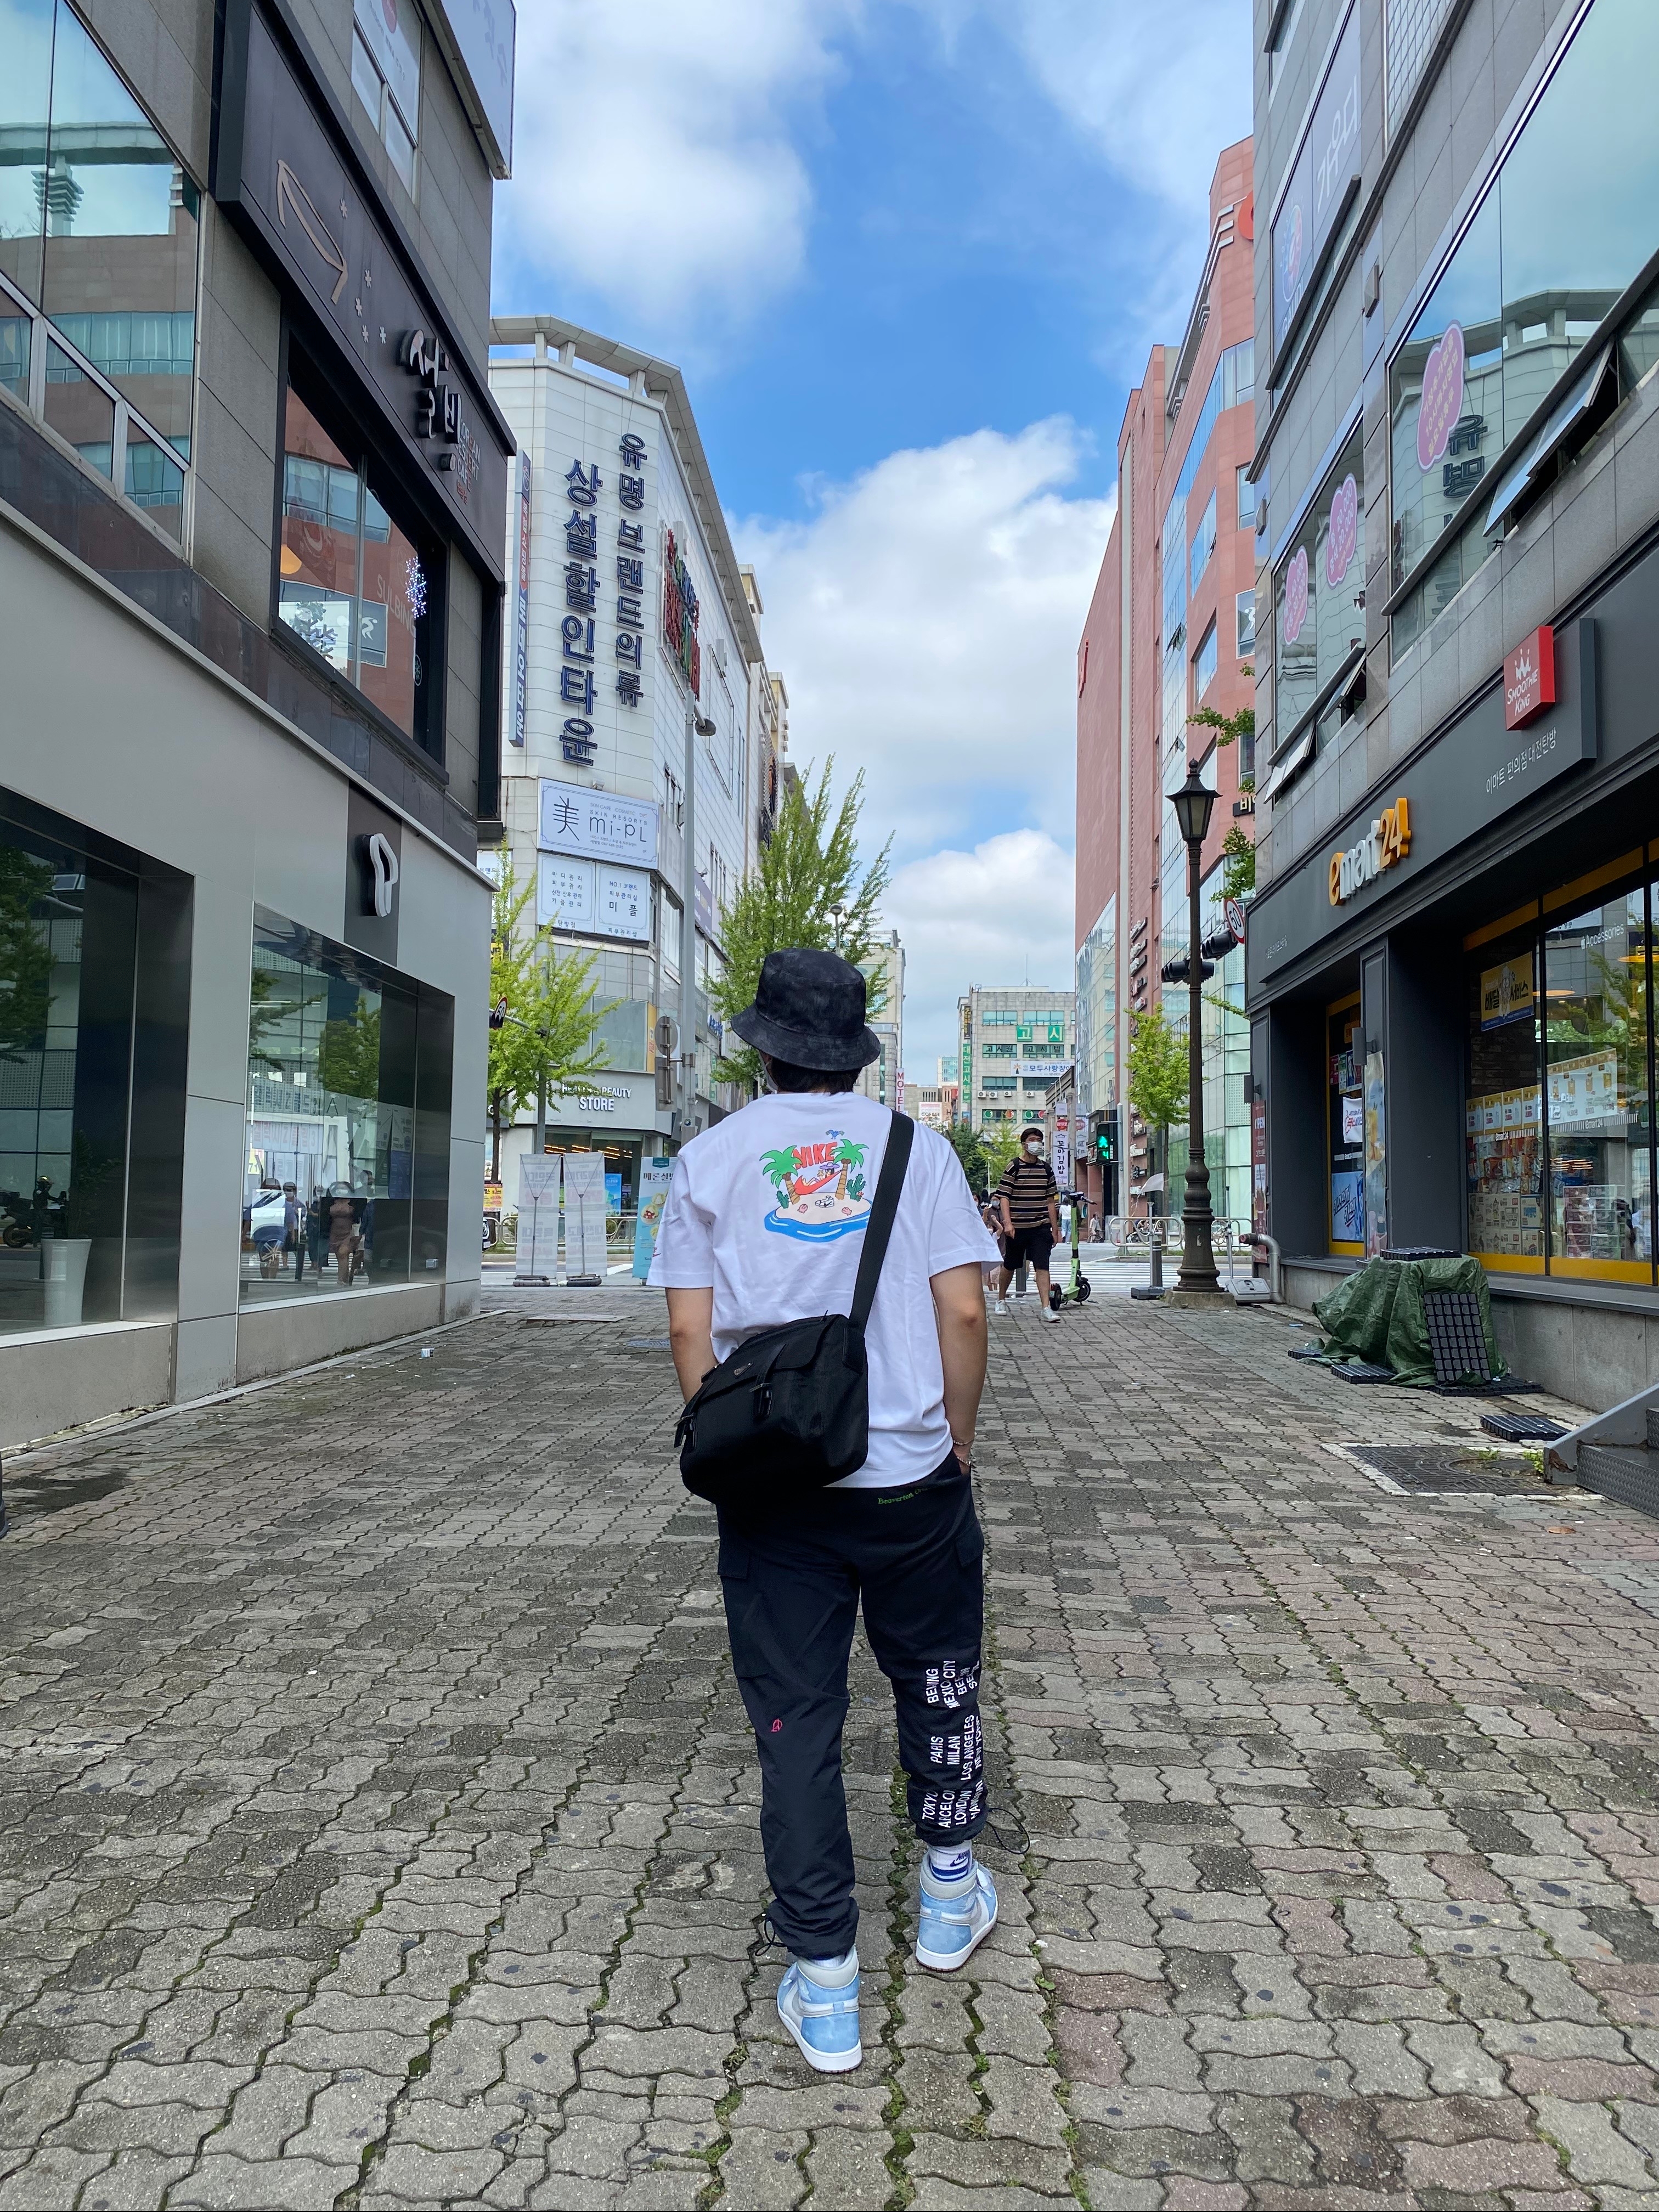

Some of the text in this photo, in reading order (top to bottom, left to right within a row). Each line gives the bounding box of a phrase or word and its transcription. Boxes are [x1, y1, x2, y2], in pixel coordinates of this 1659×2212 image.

[1317, 74, 1358, 213] 가우디
[617, 432, 647, 708] 유명브랜드의류
[377, 574, 416, 638] SULBING
[560, 459, 602, 766] 상설할인타운
[1507, 668, 1538, 706] SMOOTHIE
[1486, 727, 1556, 794] 이마트 편의점 대전탄방
[552, 795, 579, 841] 美
[590, 809, 647, 826] SKIN RESORTS
[1329, 797, 1412, 906] emart24
[624, 883, 638, 891] 브랜드
[1228, 907, 1242, 931] 50
[1585, 923, 1624, 948] Accessories
[963, 1045, 971, 1094] 대전고시텔
[579, 1096, 615, 1111] STORE
[601, 1086, 632, 1098] BEAUTY
[793, 1141, 838, 1170] NIKE
[1057, 1140, 1065, 1175] 꼬마김밥
[1103, 1151, 1109, 1160] 4
[940, 1661, 961, 1709] MEXICO CITY
[930, 1736, 944, 1765] PARIS
[947, 1735, 961, 1766] MILAN
[960, 1714, 974, 1781] LOS ANGELES
[974, 1752, 983, 1770] NEW
[954, 1790, 972, 1826] LONDON
